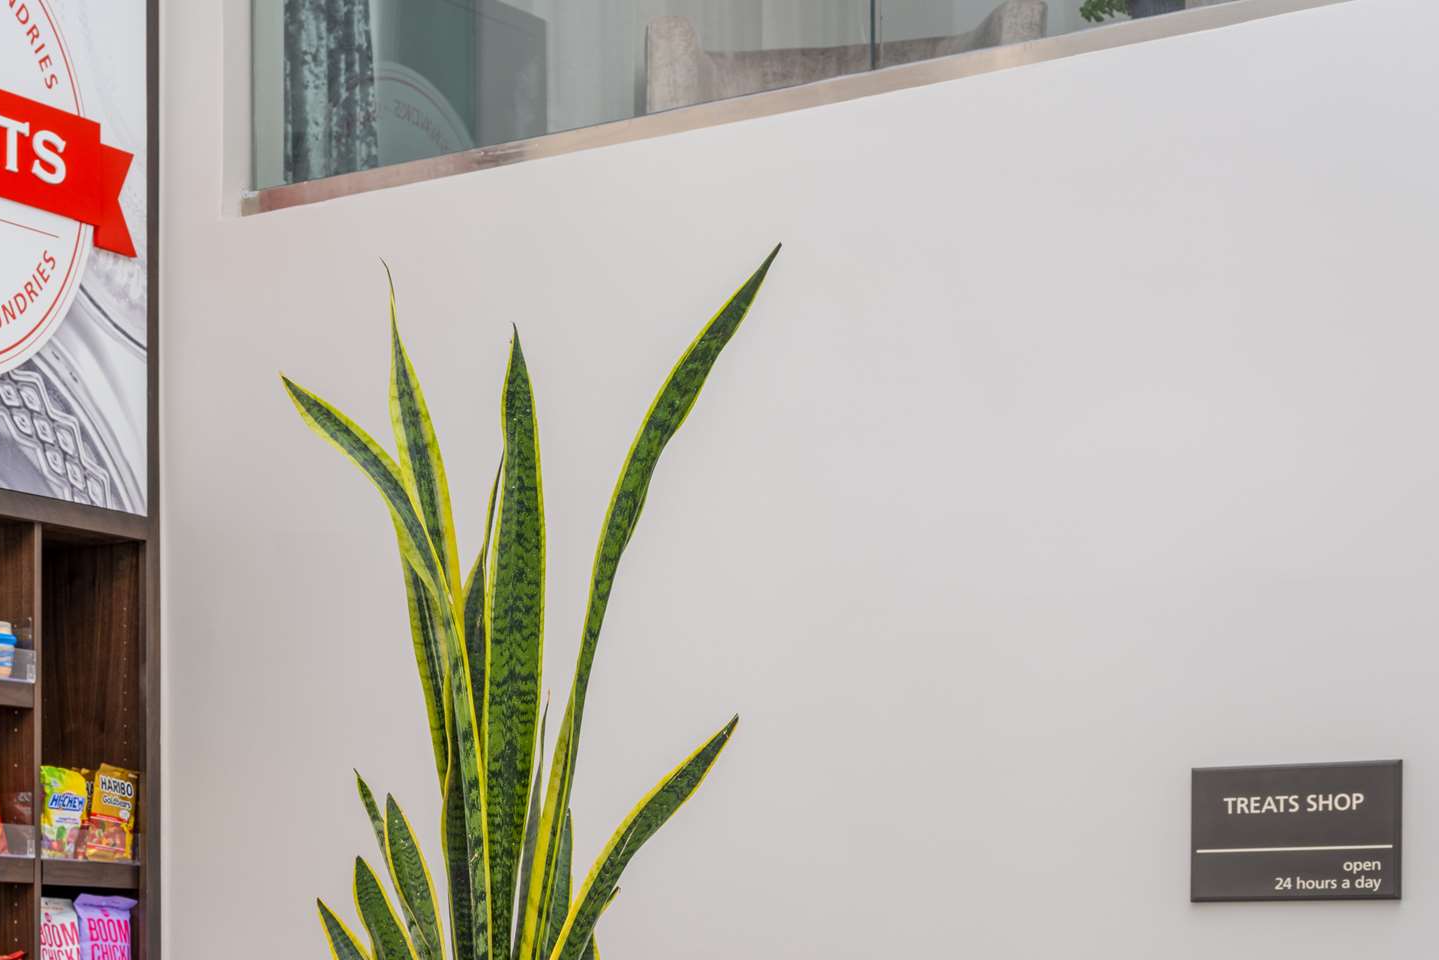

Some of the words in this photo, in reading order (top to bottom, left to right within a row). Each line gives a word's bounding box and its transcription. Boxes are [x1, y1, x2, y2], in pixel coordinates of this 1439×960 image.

[8, 0, 58, 89] DRIES
[101, 776, 134, 798] HARIBO
[1224, 795, 1300, 815] TREATS
[1306, 793, 1365, 812] SHOP
[1343, 860, 1382, 874] open
[1274, 878, 1293, 890] 24
[1296, 877, 1337, 890] hours
[1341, 879, 1351, 889] a
[1355, 876, 1382, 891] day
